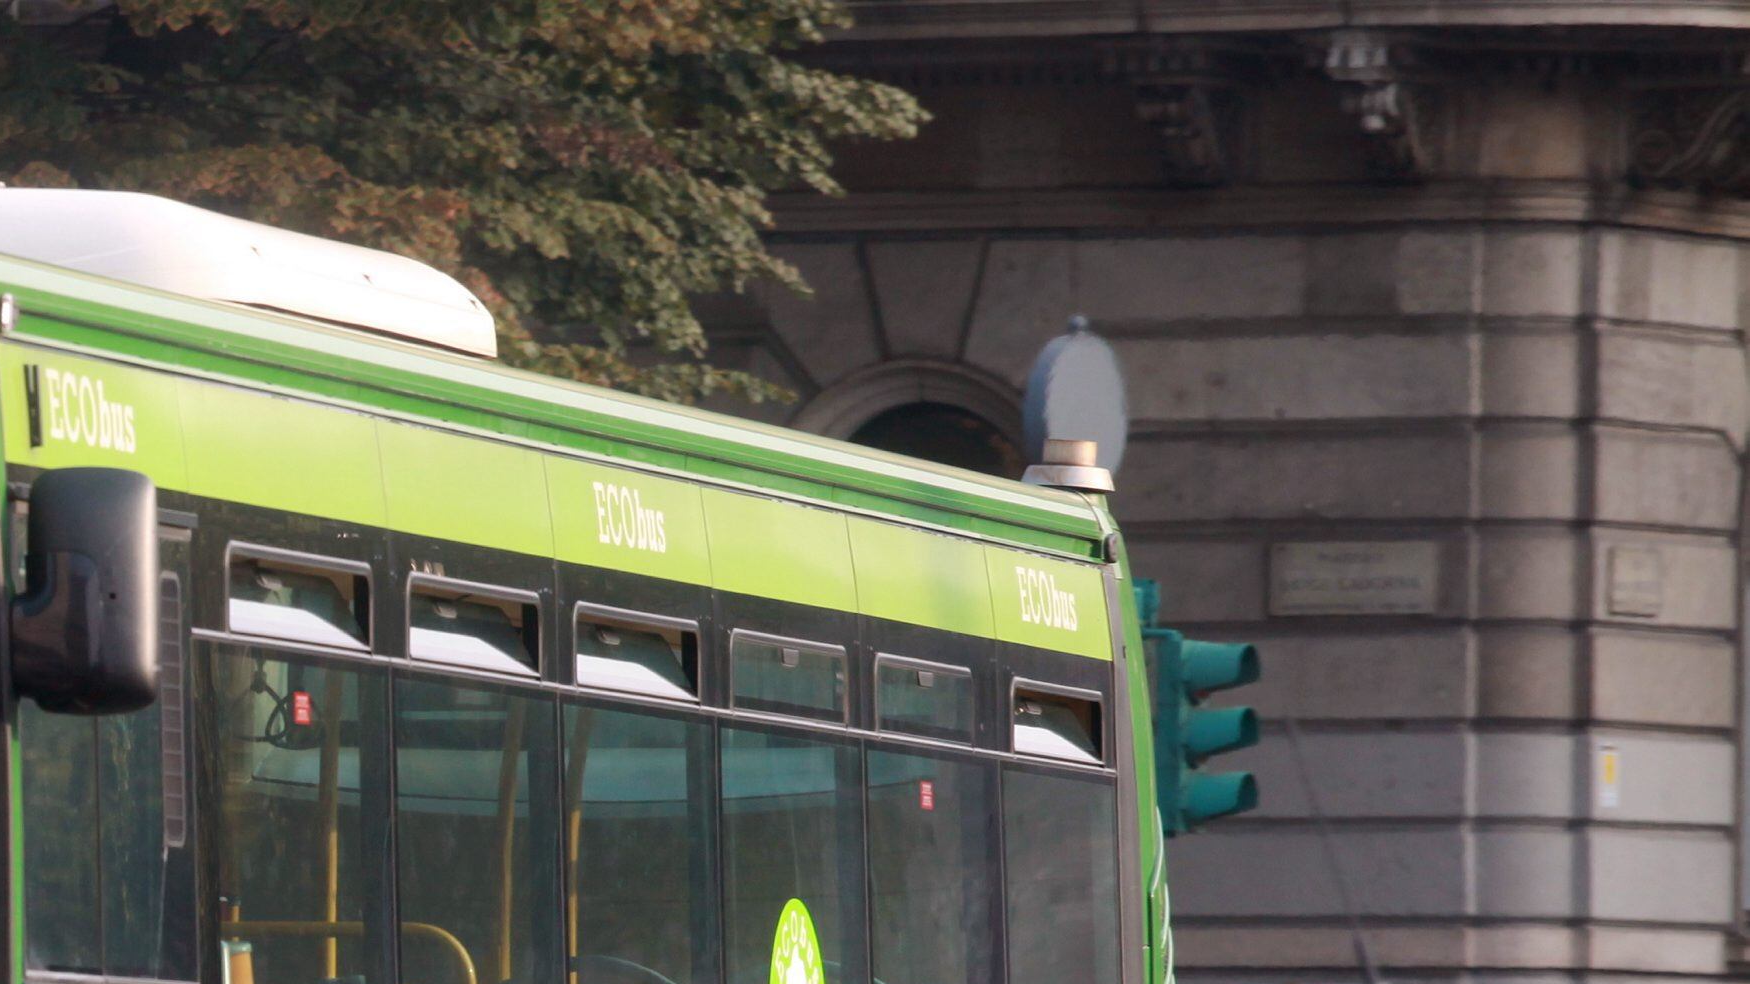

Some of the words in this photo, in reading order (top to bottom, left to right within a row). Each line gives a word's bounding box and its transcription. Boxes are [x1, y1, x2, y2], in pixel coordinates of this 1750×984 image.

[44, 368, 137, 455] ECObus
[592, 481, 666, 553] ECObus
[1015, 566, 1078, 632] ECObus
